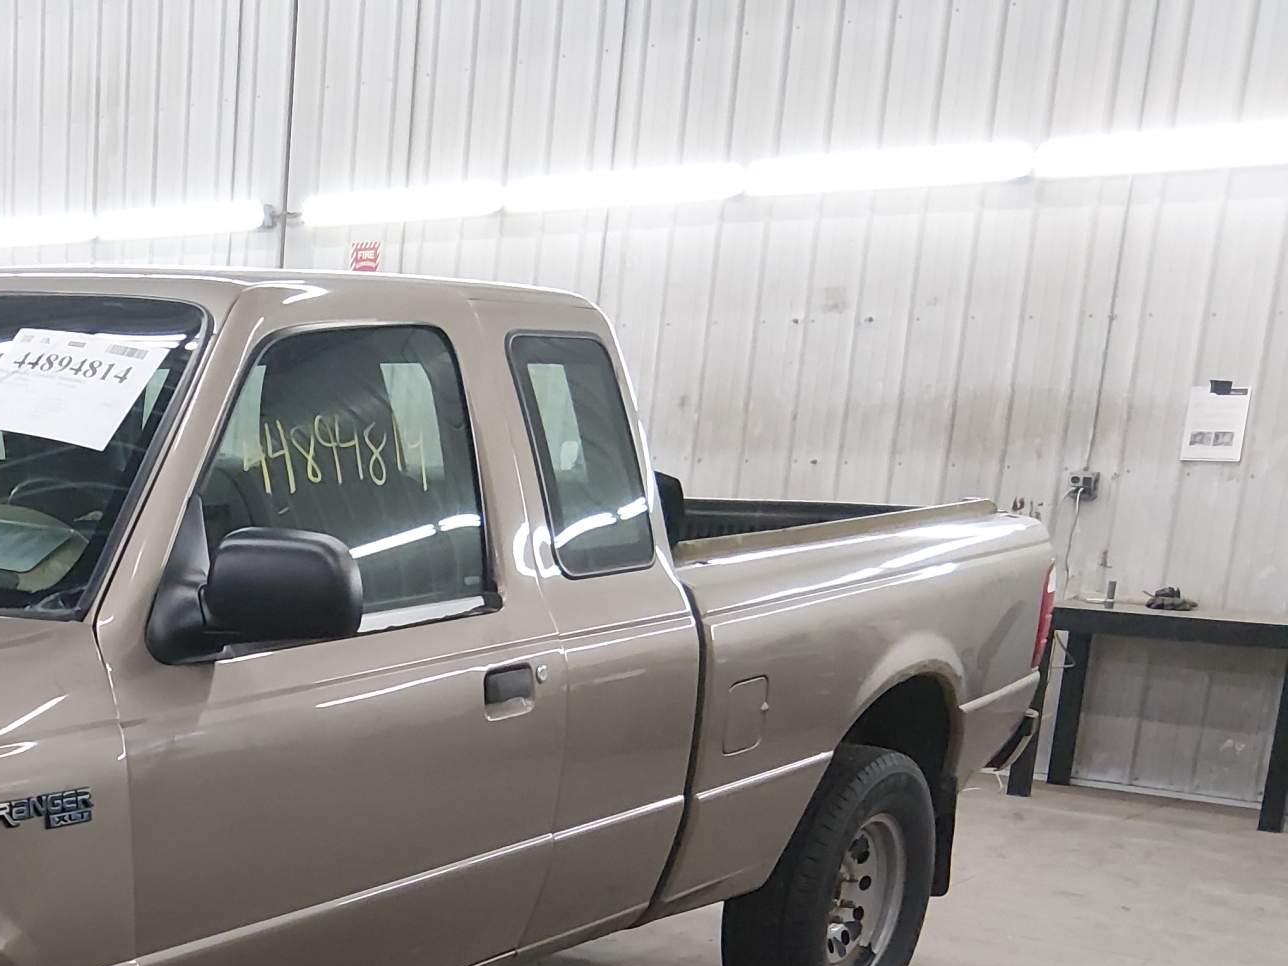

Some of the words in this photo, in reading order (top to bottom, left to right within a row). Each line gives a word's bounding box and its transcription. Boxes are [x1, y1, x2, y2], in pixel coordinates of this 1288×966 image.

[14, 352, 133, 384] 44894814
[243, 414, 428, 494] 44894814
[53, 810, 90, 825] XLT
